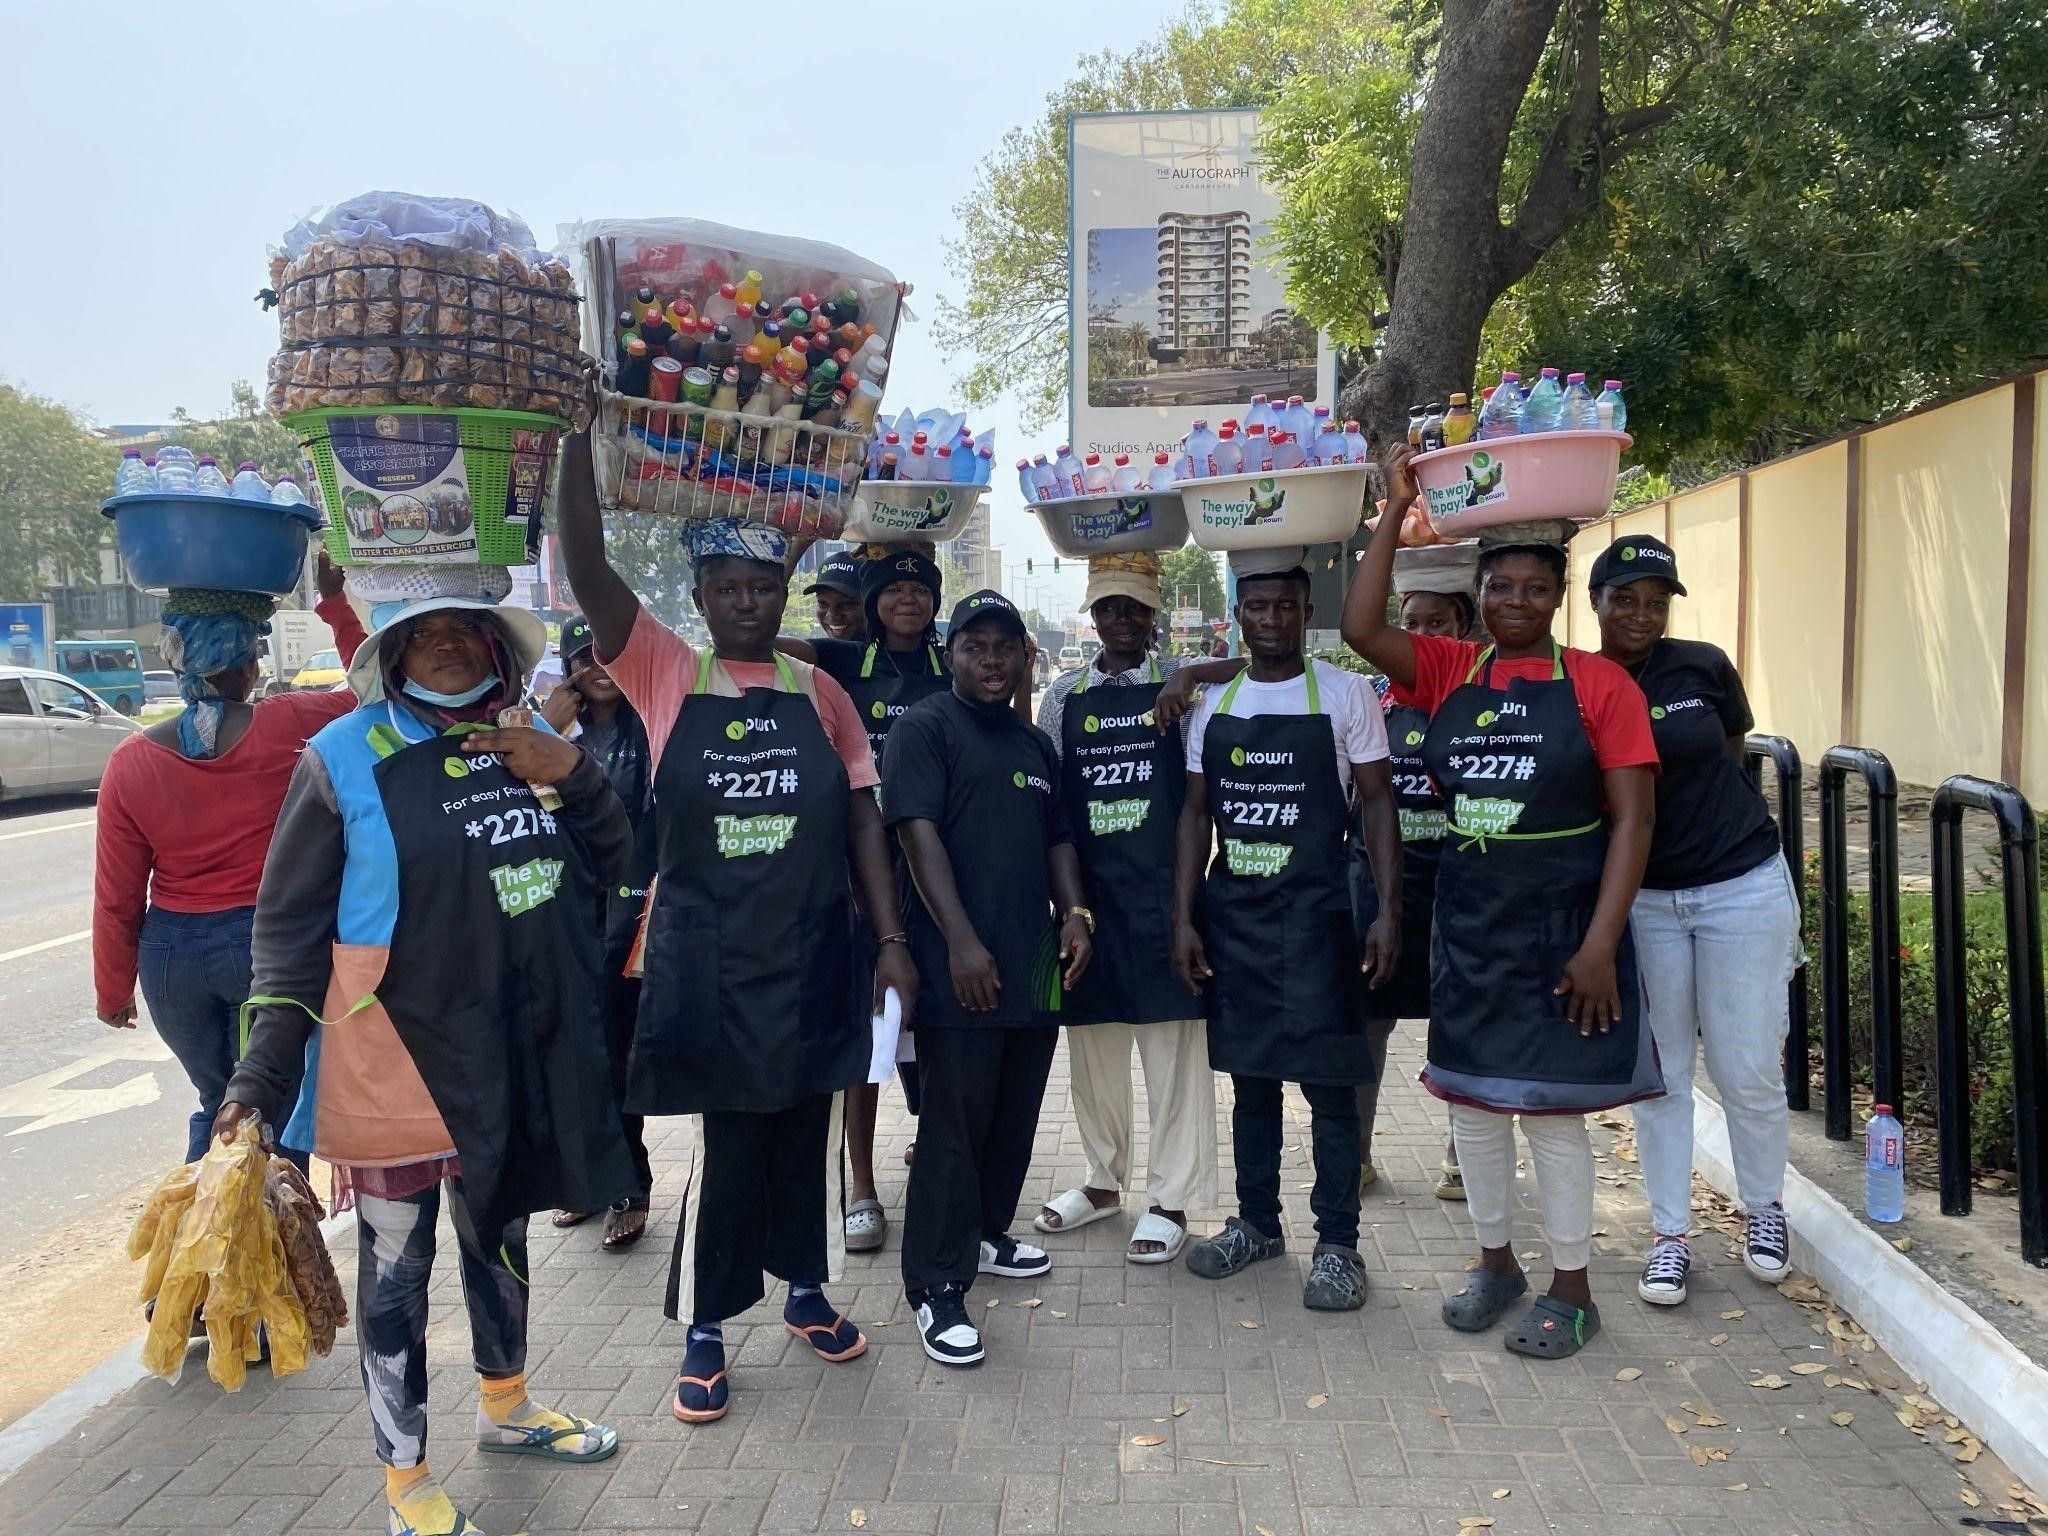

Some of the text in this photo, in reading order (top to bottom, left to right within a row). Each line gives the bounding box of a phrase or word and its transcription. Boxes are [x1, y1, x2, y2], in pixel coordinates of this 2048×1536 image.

[1172, 168, 1249, 179] AUTOGRAPH
[354, 456, 436, 472] ASSOCIATION
[377, 474, 416, 482] PRESENTS
[1427, 483, 1472, 501] The way
[874, 501, 928, 522] The way
[1201, 499, 1253, 516] The way
[1431, 495, 1465, 516] to pay!
[871, 512, 916, 531] to pay!
[1070, 513, 1124, 526] The way
[1203, 512, 1243, 529] to pay!
[1072, 525, 1115, 539] to pay!
[354, 541, 472, 557] EASTER CLEAN-UP EXERCISE
[1076, 740, 1156, 756] For easy payment
[1489, 733, 1544, 746] payment
[703, 750, 725, 761] For
[751, 746, 798, 763] payment
[1220, 779, 1306, 793] For easy payment
[442, 797, 468, 815] For
[471, 788, 501, 803] easy
[1088, 801, 1150, 816] The way
[1455, 795, 1523, 820] The way
[1090, 813, 1141, 832] to pay!
[1399, 808, 1448, 823] The wa
[1456, 813, 1509, 833] to pay!
[716, 816, 796, 834] The way
[1414, 822, 1449, 840] pay!
[719, 831, 784, 854] to pay!
[1225, 840, 1292, 861] The way
[1228, 855, 1281, 876] to pay!
[491, 862, 533, 891] The
[499, 890, 522, 910] to
